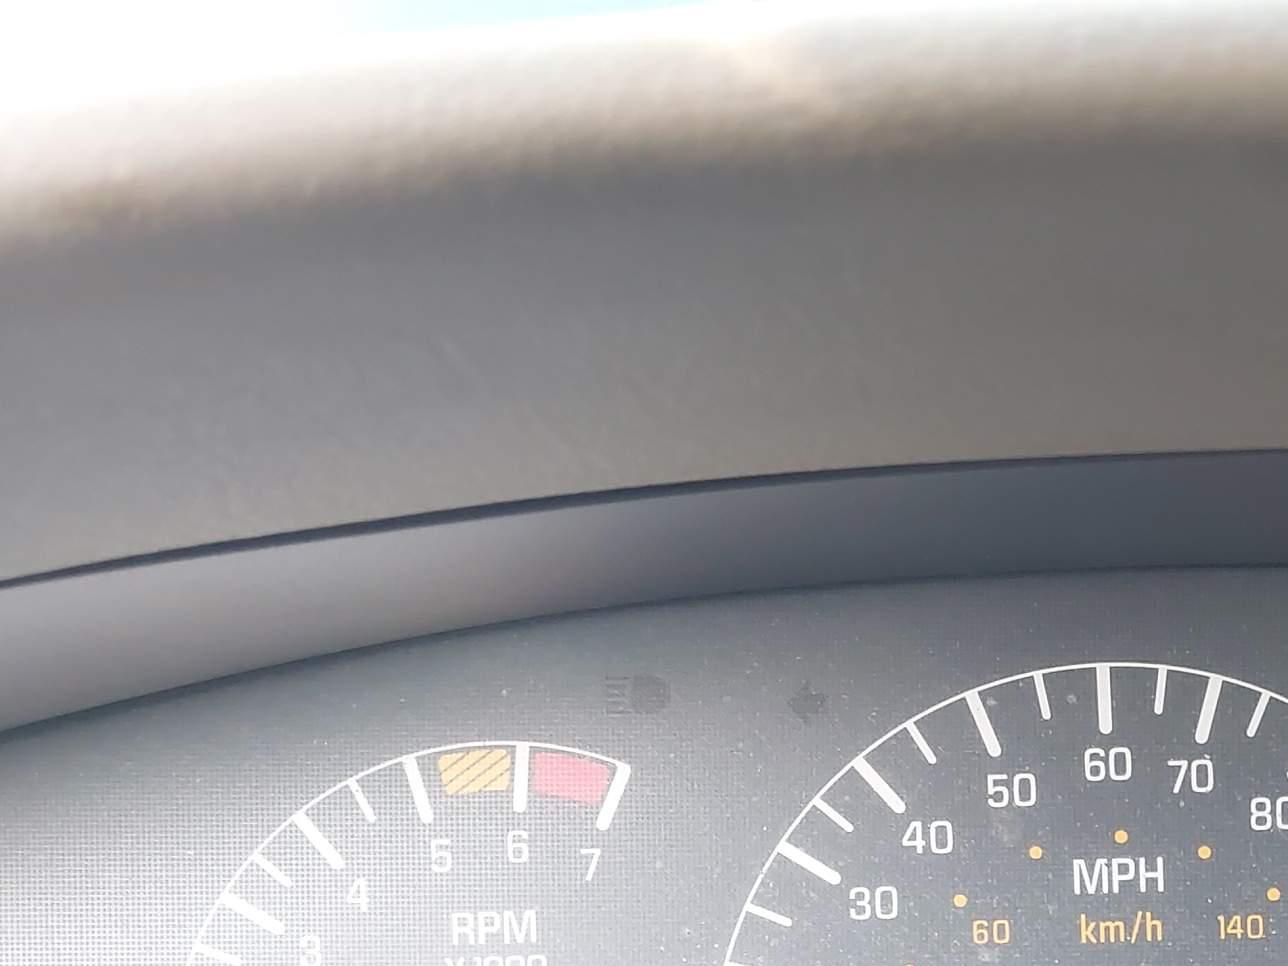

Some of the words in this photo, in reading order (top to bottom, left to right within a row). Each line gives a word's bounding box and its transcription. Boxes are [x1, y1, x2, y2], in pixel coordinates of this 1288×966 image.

[1085, 747, 1131, 781] 60
[1168, 760, 1213, 793] 70
[988, 774, 1036, 807] 50
[507, 830, 529, 862] 6
[902, 821, 953, 853] 40
[431, 838, 452, 873] 5
[580, 849, 601, 881] 7
[1073, 857, 1163, 894] MPH
[348, 878, 370, 912] 4
[850, 886, 897, 920] 30
[451, 910, 536, 946] RPM
[973, 920, 1009, 944] 60
[1081, 912, 1162, 943] km/h
[1218, 915, 1264, 939] 140
